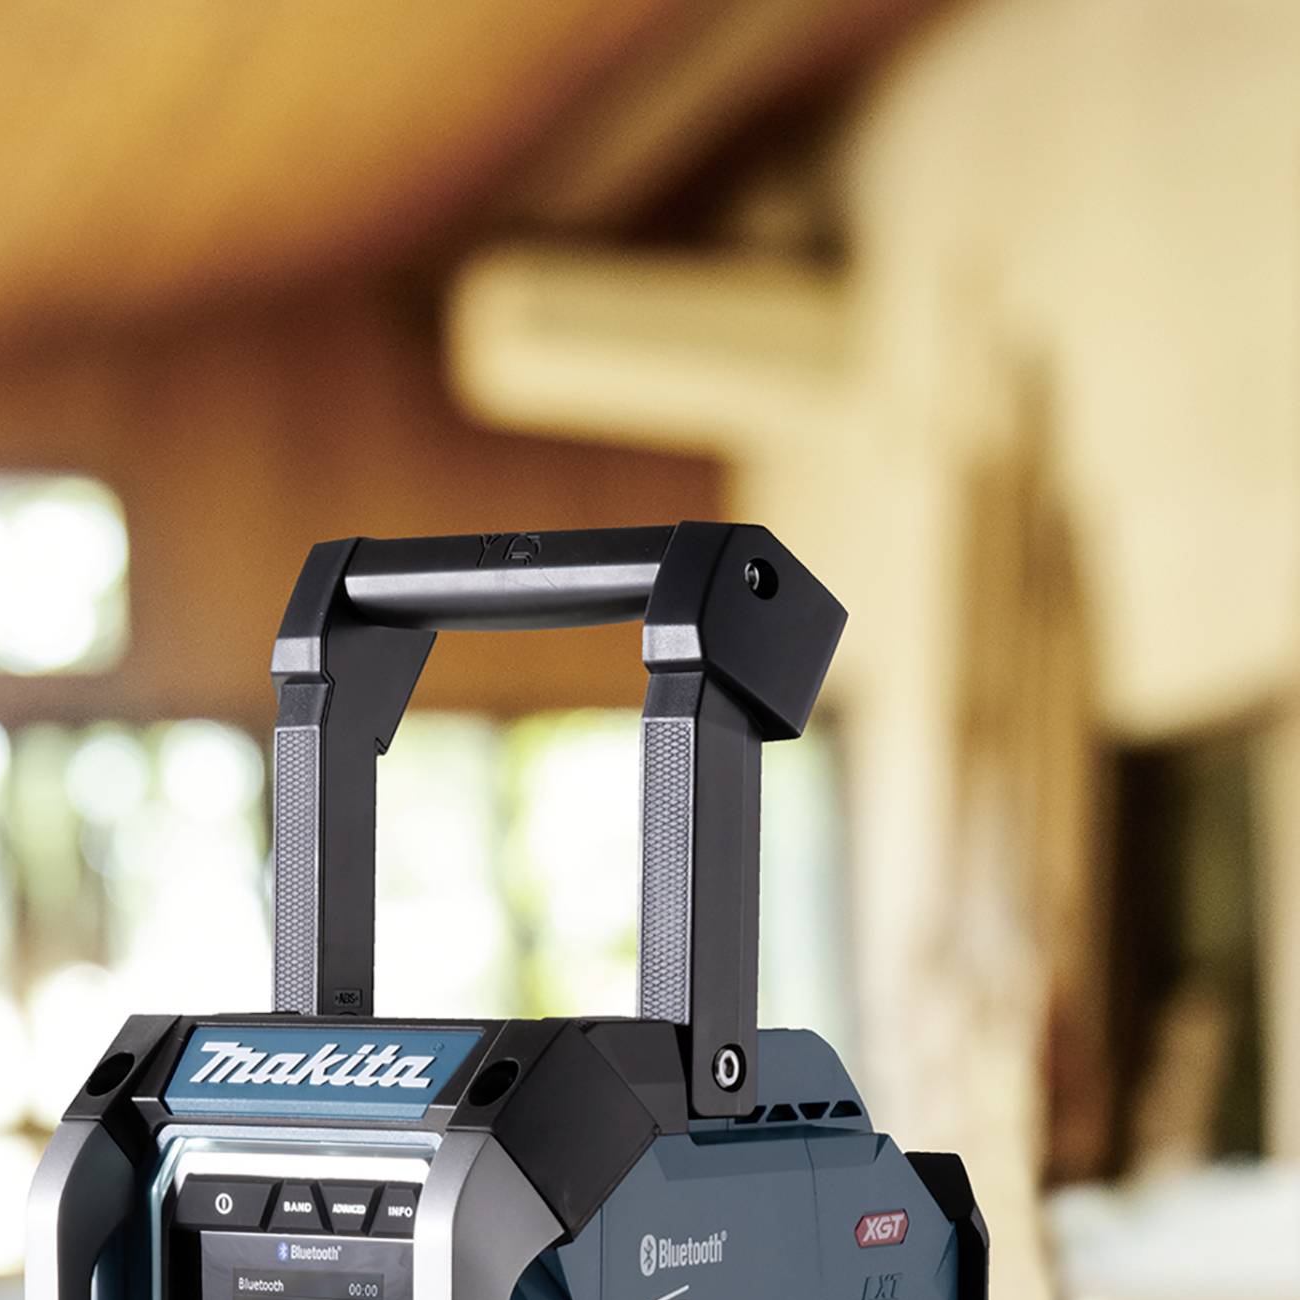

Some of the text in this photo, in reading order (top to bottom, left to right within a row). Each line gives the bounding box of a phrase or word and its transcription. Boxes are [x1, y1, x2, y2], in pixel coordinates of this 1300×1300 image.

[189, 1042, 435, 1088] Makita
[283, 1201, 312, 1213] BAND
[388, 1206, 413, 1218] INFO
[862, 1213, 905, 1243] XGT
[238, 1277, 284, 1292] Bluetooth
[348, 1283, 378, 1297] 00:00
